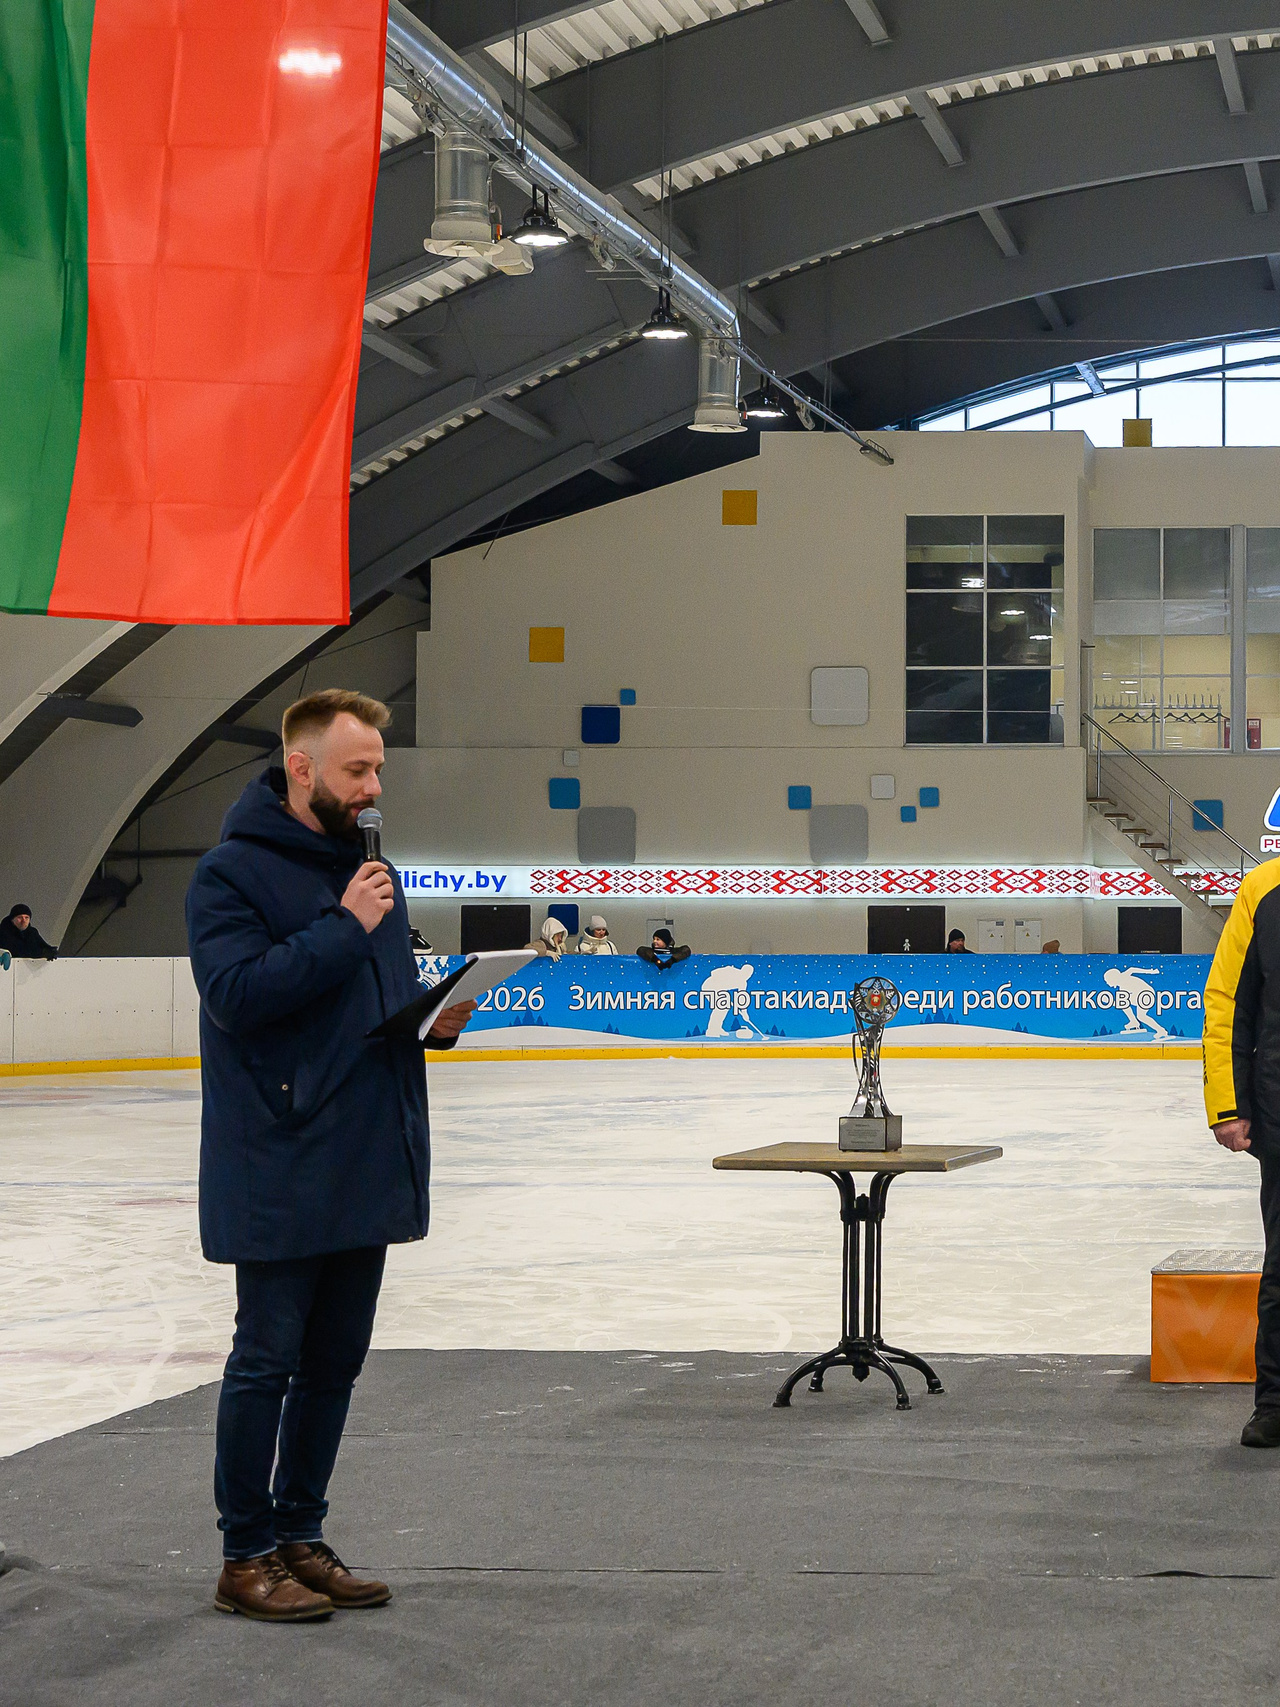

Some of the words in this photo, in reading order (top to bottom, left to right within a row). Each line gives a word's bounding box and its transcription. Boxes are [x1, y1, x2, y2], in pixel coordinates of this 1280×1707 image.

[398, 870, 507, 893] lichy.by
[477, 985, 545, 1012] 2026
[568, 984, 676, 1011] Зимняя
[897, 989, 955, 1014] еди
[962, 982, 1131, 1015] работников
